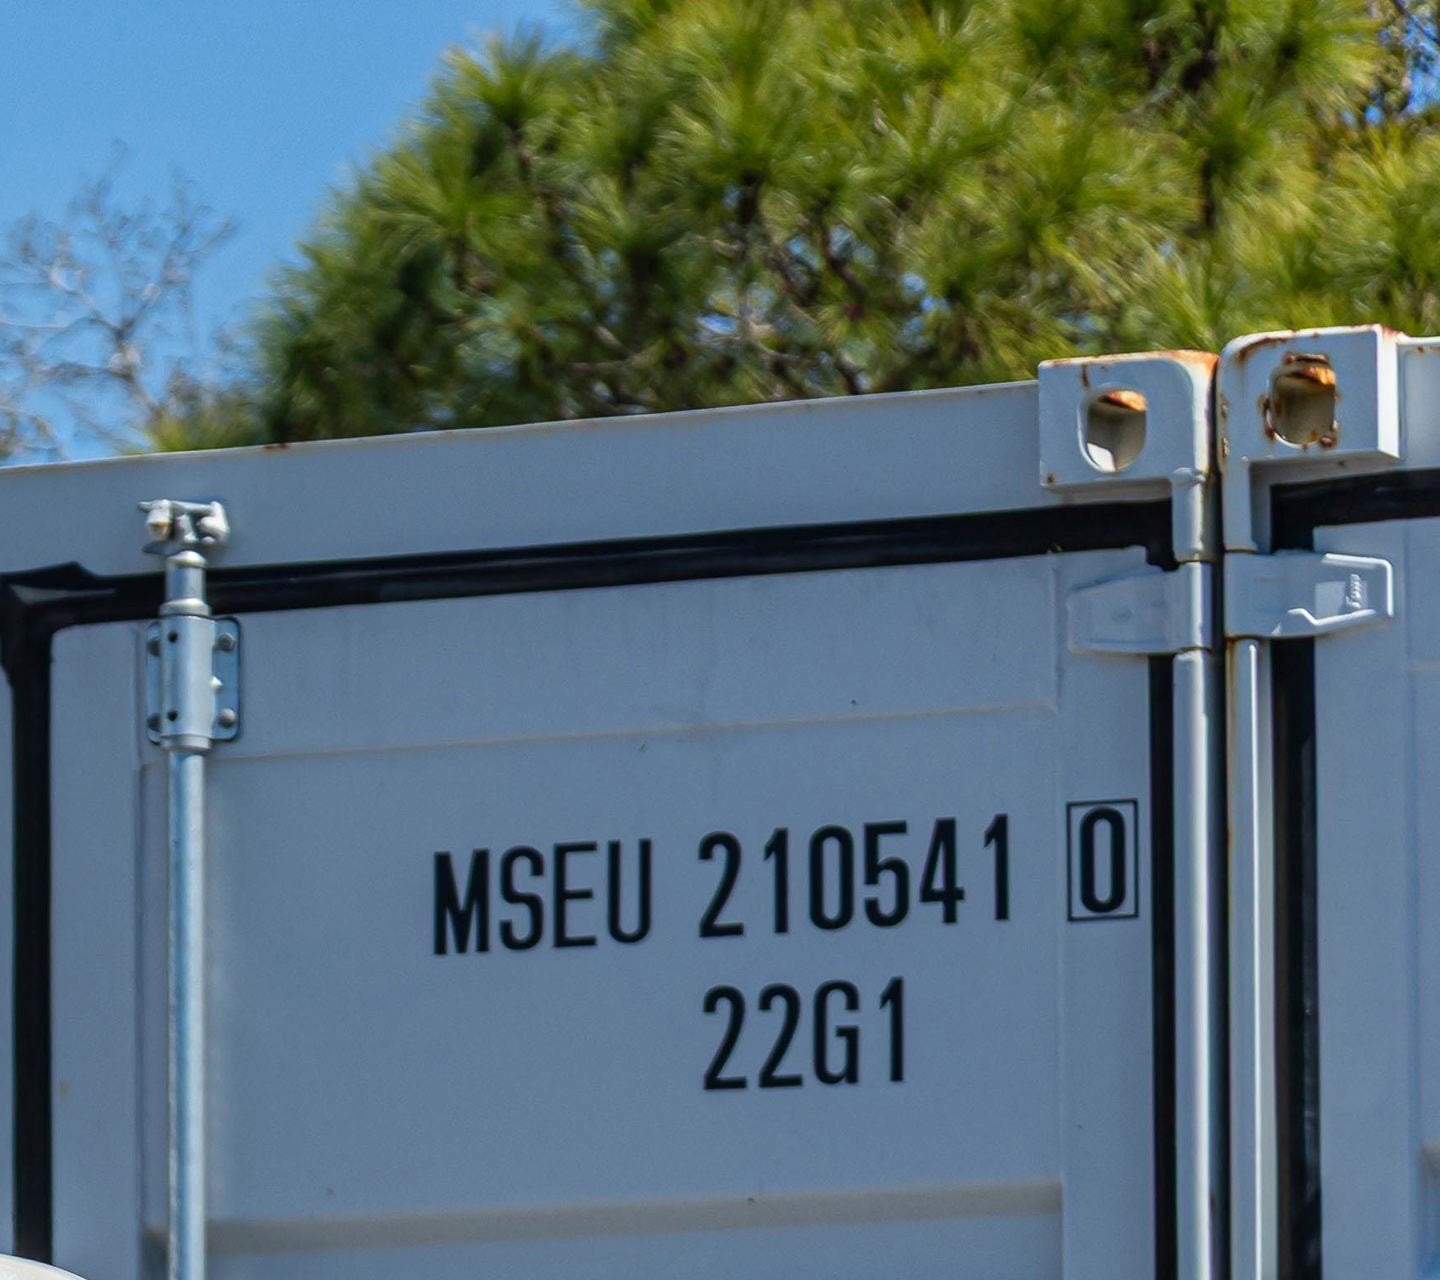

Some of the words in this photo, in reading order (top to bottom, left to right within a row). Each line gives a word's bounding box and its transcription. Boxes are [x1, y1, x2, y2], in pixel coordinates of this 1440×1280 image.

[432, 838, 653, 957] MSEU
[697, 813, 1010, 940] 210541
[1081, 806, 1128, 916] 0
[702, 976, 905, 1092] 22G1
